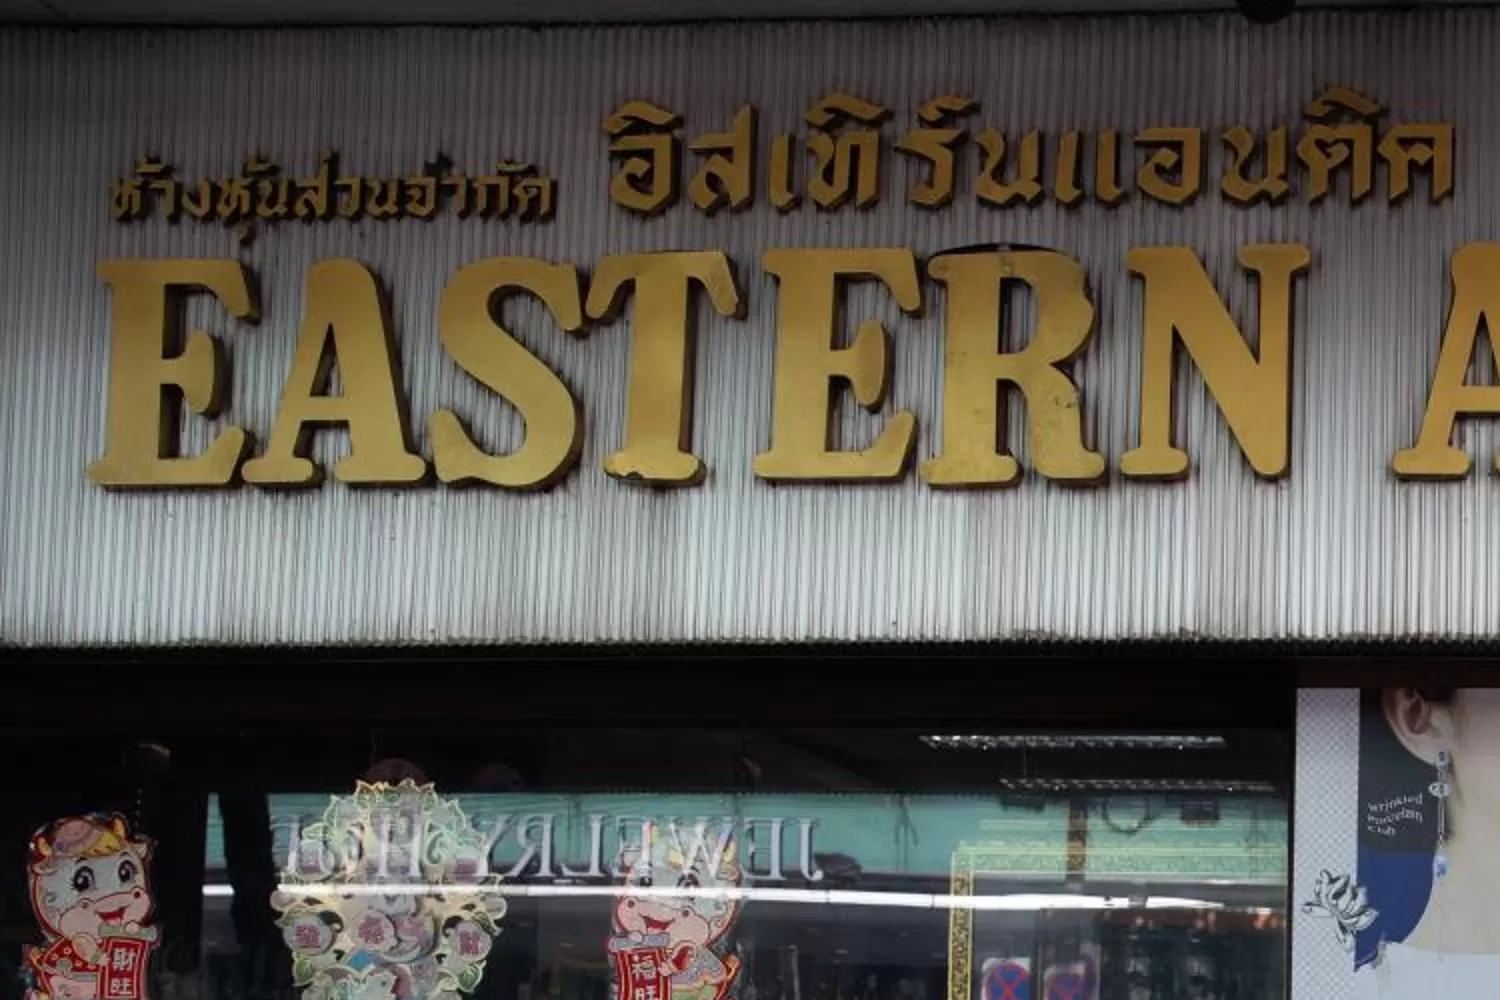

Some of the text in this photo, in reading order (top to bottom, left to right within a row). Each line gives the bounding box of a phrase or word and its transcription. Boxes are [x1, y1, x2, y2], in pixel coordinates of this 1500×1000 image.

[112, 153, 557, 245] ห้างหุ้นส่วนจำกัด
[86, 243, 1311, 490] EASTERN
[1368, 792, 1424, 813] Wrinkled
